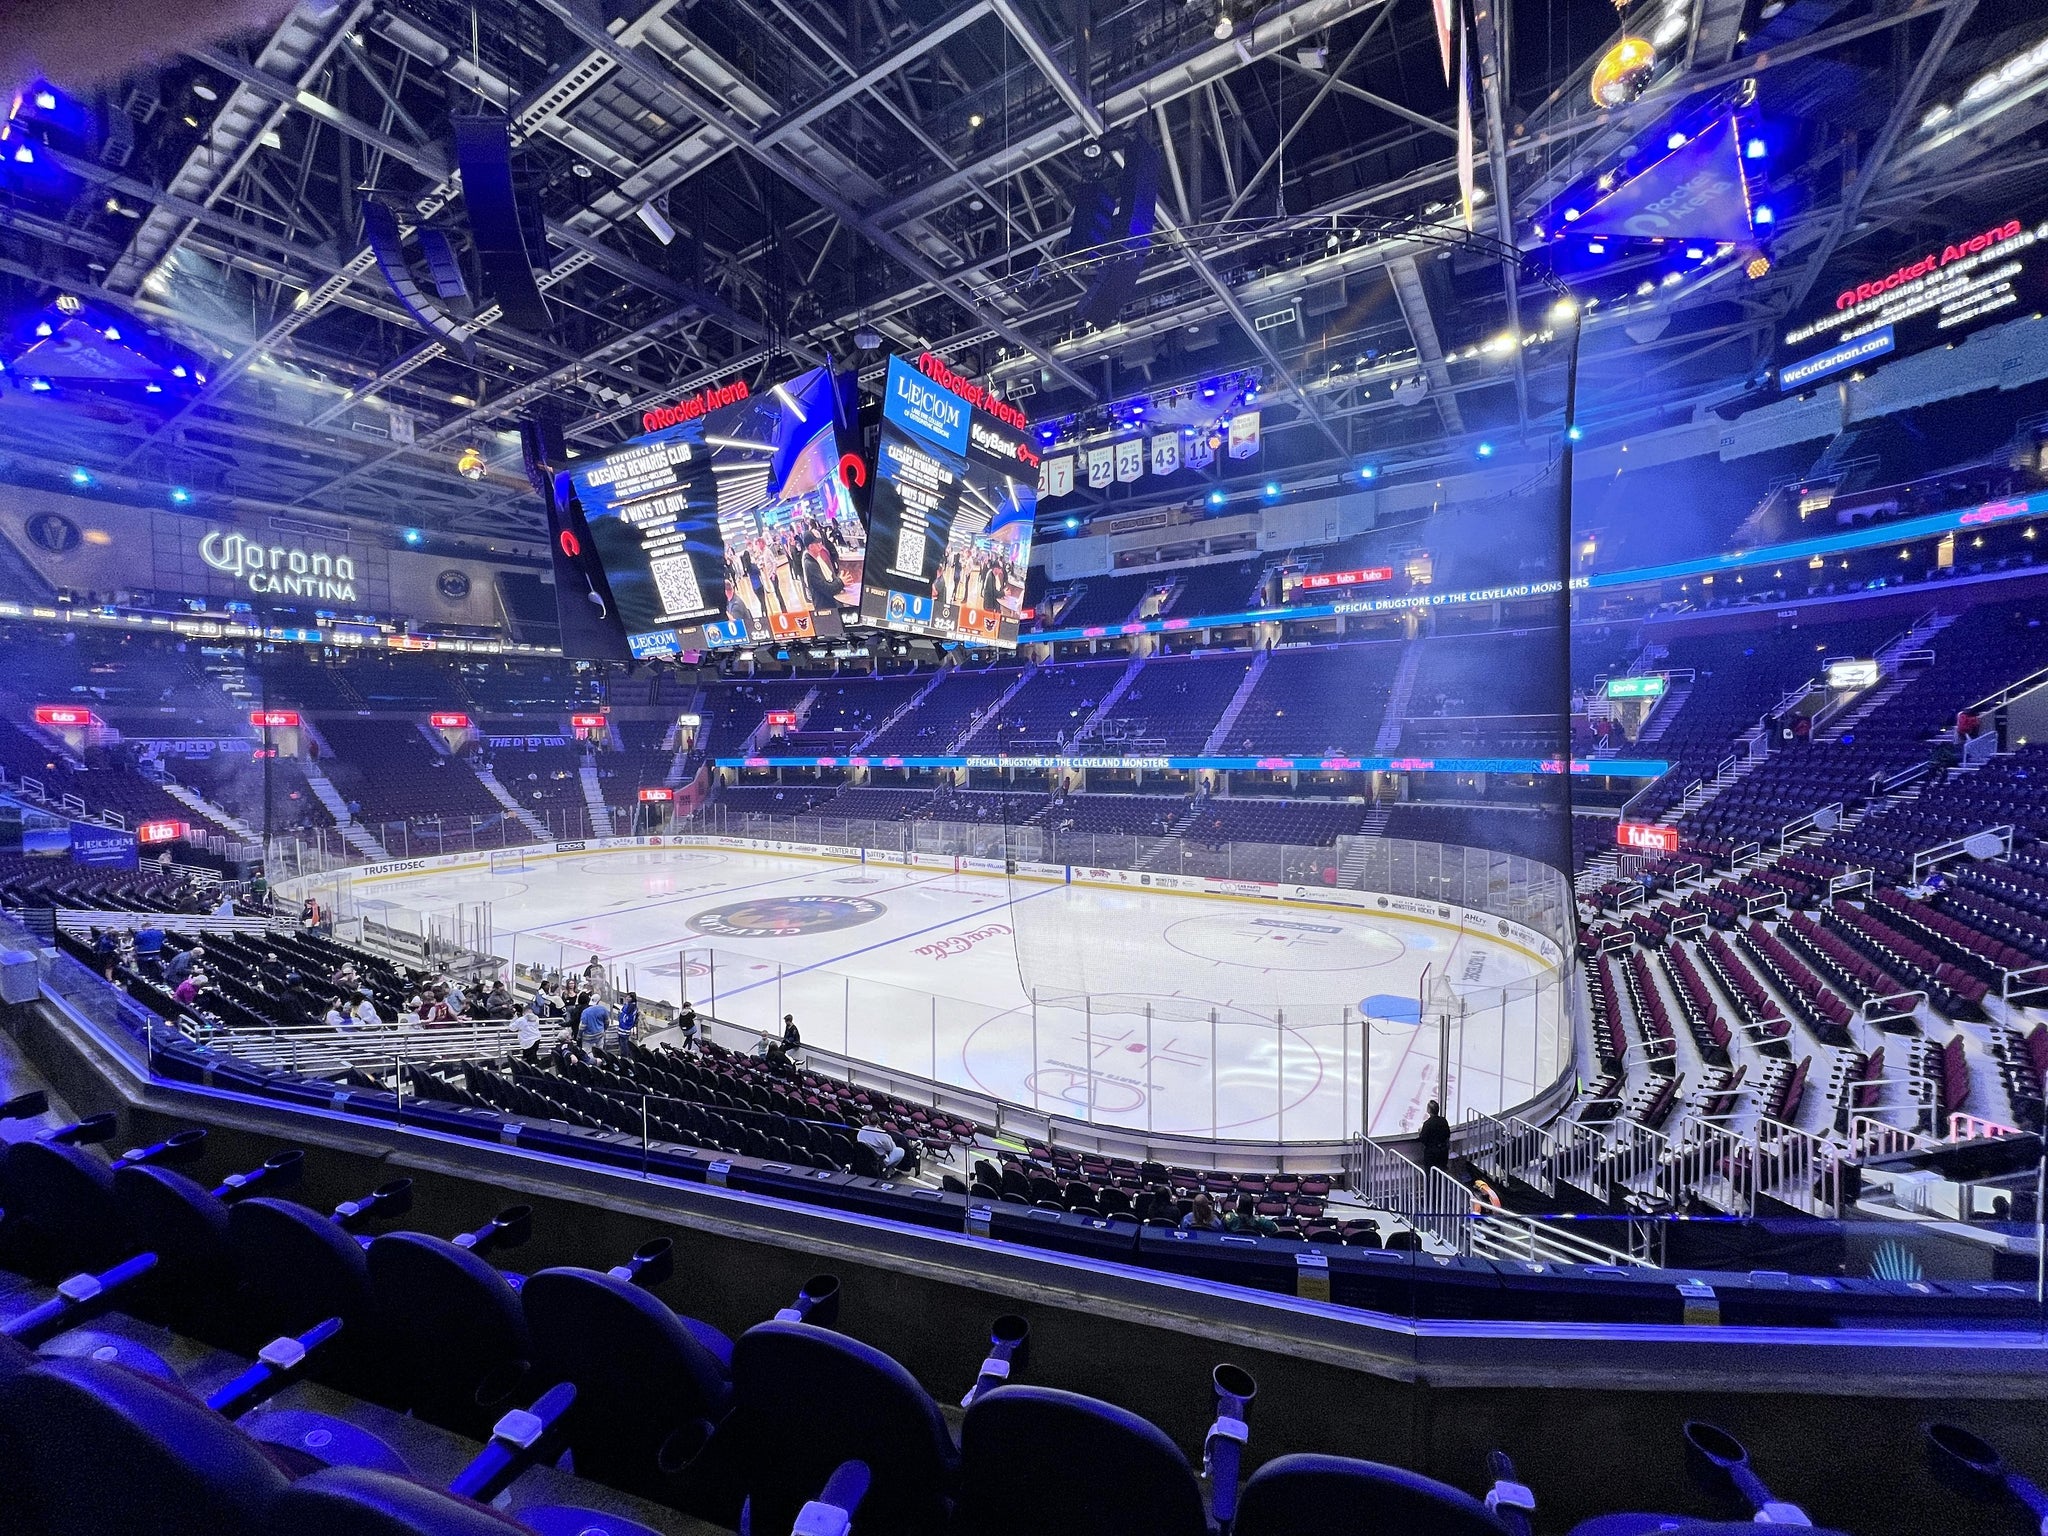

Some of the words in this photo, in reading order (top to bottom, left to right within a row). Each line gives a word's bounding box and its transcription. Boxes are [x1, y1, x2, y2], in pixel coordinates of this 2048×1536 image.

[1857, 254, 1937, 301] Rocket
[1941, 220, 2021, 266] Arena
[1786, 326, 1815, 344] Want
[1815, 307, 1856, 333] Closed
[1856, 280, 1924, 315] Captioning
[1926, 270, 1945, 286] on
[1945, 257, 1979, 280] your
[1978, 231, 2036, 263] mobile
[1880, 300, 1907, 318] Scan
[1907, 293, 1925, 309] the
[1941, 276, 1970, 294] Code
[1940, 289, 1994, 315] WELCOME
[1993, 282, 2011, 294] TO
[1937, 308, 1980, 330] ROCKET
[1980, 294, 2017, 314] ARENA
[1783, 336, 1889, 384] WeCutCarbon.com
[933, 358, 984, 408] Rocket
[983, 394, 1026, 430] Arena
[655, 393, 707, 429] Rocket
[706, 381, 749, 412] Arena
[971, 424, 1017, 459] KeyBank
[1190, 440, 1208, 461] 11
[606, 447, 650, 466] EXPERIENCE
[650, 441, 666, 454] THE
[1156, 446, 1176, 468] 43
[587, 462, 628, 487] CAESARS
[627, 451, 669, 481] REWARDS
[668, 443, 692, 465] CLUB
[1091, 461, 1111, 481] 22
[1120, 454, 1139, 476] 25
[1058, 471, 1065, 488] 7
[620, 508, 630, 524] 4
[628, 501, 655, 522] WAYS
[653, 499, 667, 516] TO
[667, 493, 689, 513] BUY:
[201, 532, 355, 580] Corona
[249, 573, 357, 602] CANTINA
[1311, 577, 1330, 586] fubo
[1336, 574, 1356, 584] fubo
[1362, 571, 1382, 580] fubo
[1334, 603, 1373, 614] OFFICIAL
[1375, 597, 1431, 611] DRUGSTORE
[1432, 594, 1446, 604] OF
[1449, 592, 1467, 603] THE
[1469, 586, 1529, 602] CLEVELAND
[1530, 578, 1590, 594] MONSERS
[913, 597, 922, 615] 0
[779, 614, 788, 630] 0
[933, 617, 955, 631] 32:54
[968, 609, 977, 625] 0
[202, 625, 217, 634] 30
[247, 628, 262, 637] 16
[297, 631, 306, 640] 0
[729, 621, 737, 636] 0
[751, 630, 770, 641] 32:54
[332, 634, 363, 644] 32:54
[1611, 682, 1638, 694] Sprite
[175, 741, 217, 752] DEEP
[219, 740, 250, 752] END
[489, 738, 512, 747] THE
[513, 738, 542, 747] DEP
[543, 737, 566, 747] END
[966, 758, 998, 768] OFFICIAL
[999, 758, 1043, 768] DRUGSTORE
[1043, 758, 1055, 768] OF
[1056, 758, 1072, 768] THE
[1072, 758, 1120, 768] CLEVELAND
[1121, 758, 1170, 768] MONSTERS
[646, 790, 667, 799] fubo
[149, 824, 173, 840] fubo
[1627, 828, 1665, 848] fubo
[74, 837, 134, 850] LECOM
[828, 846, 850, 855] CENTER
[849, 848, 858, 856] ICE
[363, 860, 425, 876] TRUSTEDSEC
[1391, 902, 1417, 913] MONSTERS
[1417, 905, 1435, 915] HOCKEY
[910, 923, 1012, 960] Coca-Cola
[1107, 1073, 1142, 1086] PARTS
